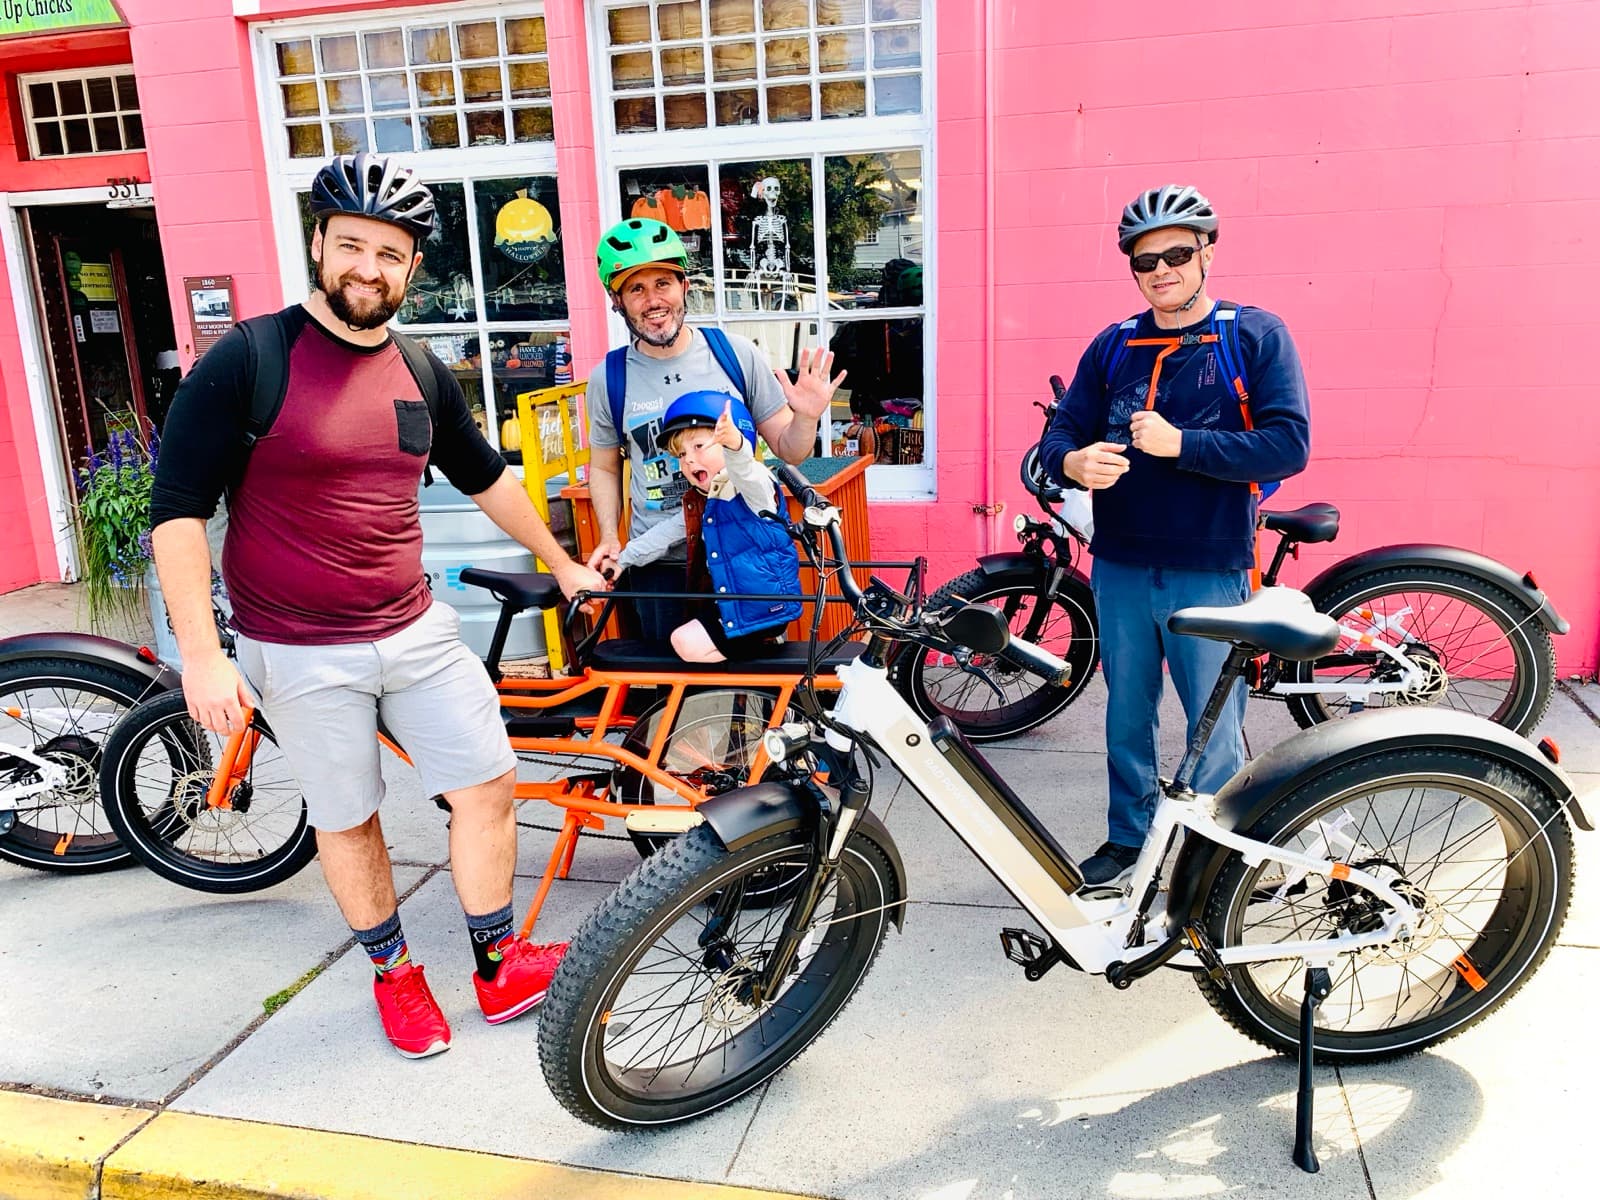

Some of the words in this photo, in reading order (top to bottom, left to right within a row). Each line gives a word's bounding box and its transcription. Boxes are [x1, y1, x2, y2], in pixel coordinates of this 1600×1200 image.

[4, 0, 22, 23] Up
[26, 0, 73, 17] Chicks
[106, 176, 140, 199] 331
